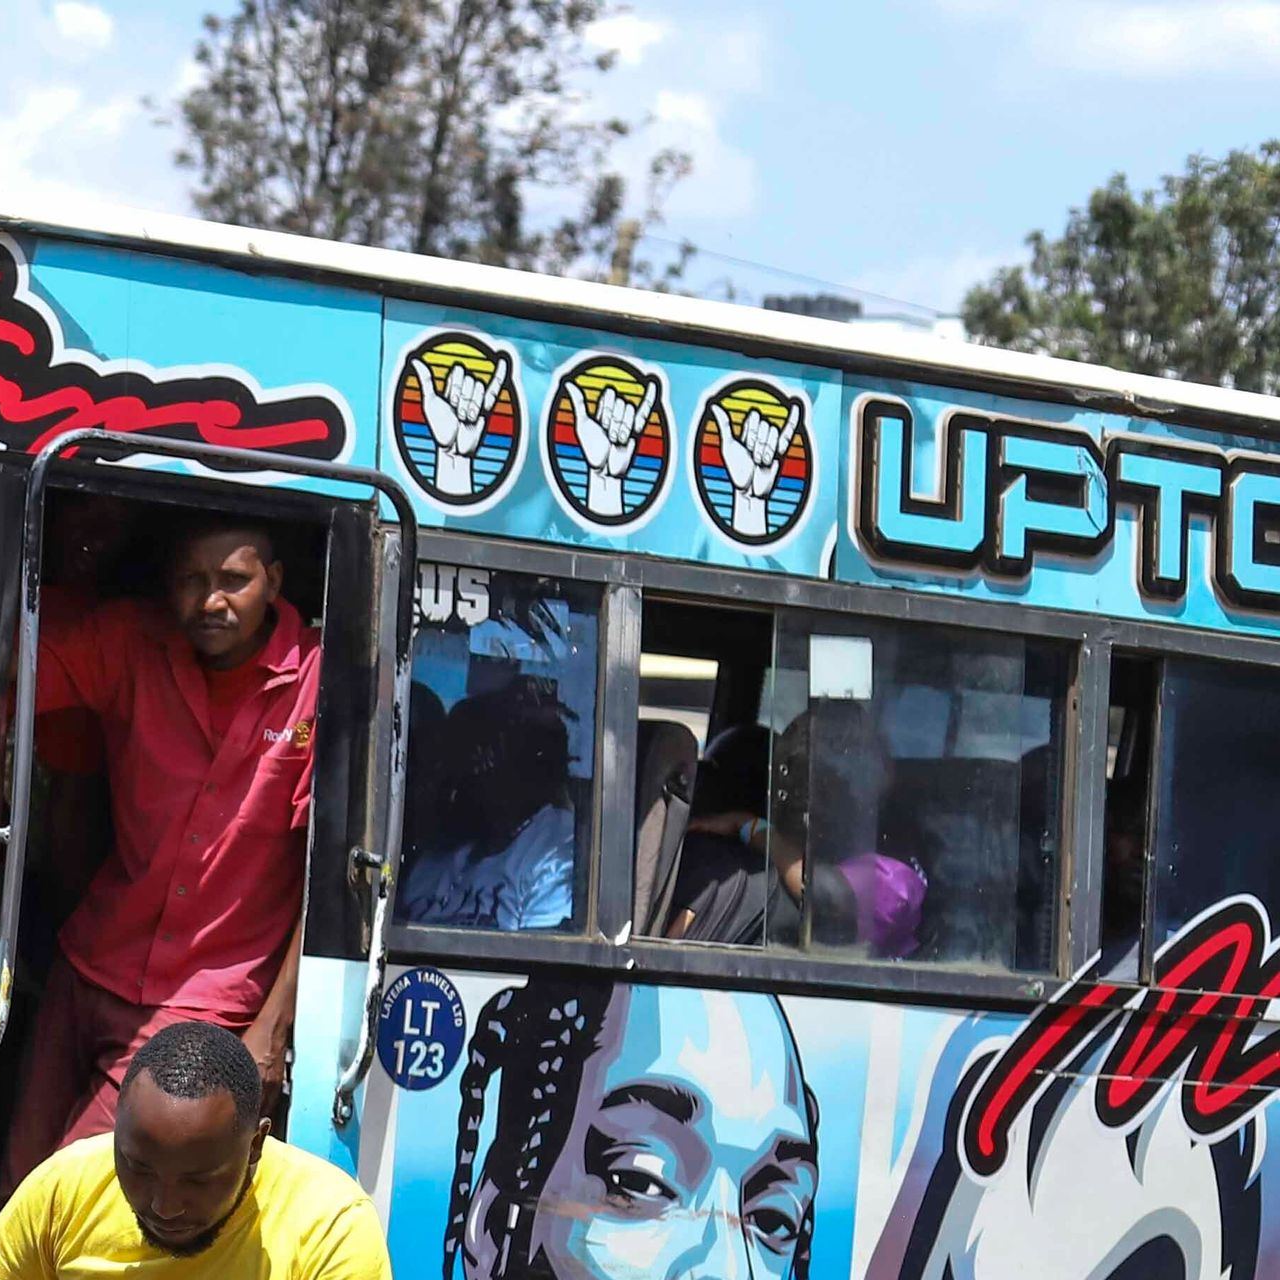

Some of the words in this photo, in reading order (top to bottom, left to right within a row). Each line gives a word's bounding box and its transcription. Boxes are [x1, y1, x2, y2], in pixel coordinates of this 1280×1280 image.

[381, 976, 411, 1019] LATEMA
[416, 971, 456, 1001] TRAVELS
[452, 1004, 464, 1027] LTD
[403, 999, 440, 1036] LT
[393, 1040, 445, 1079] 123
